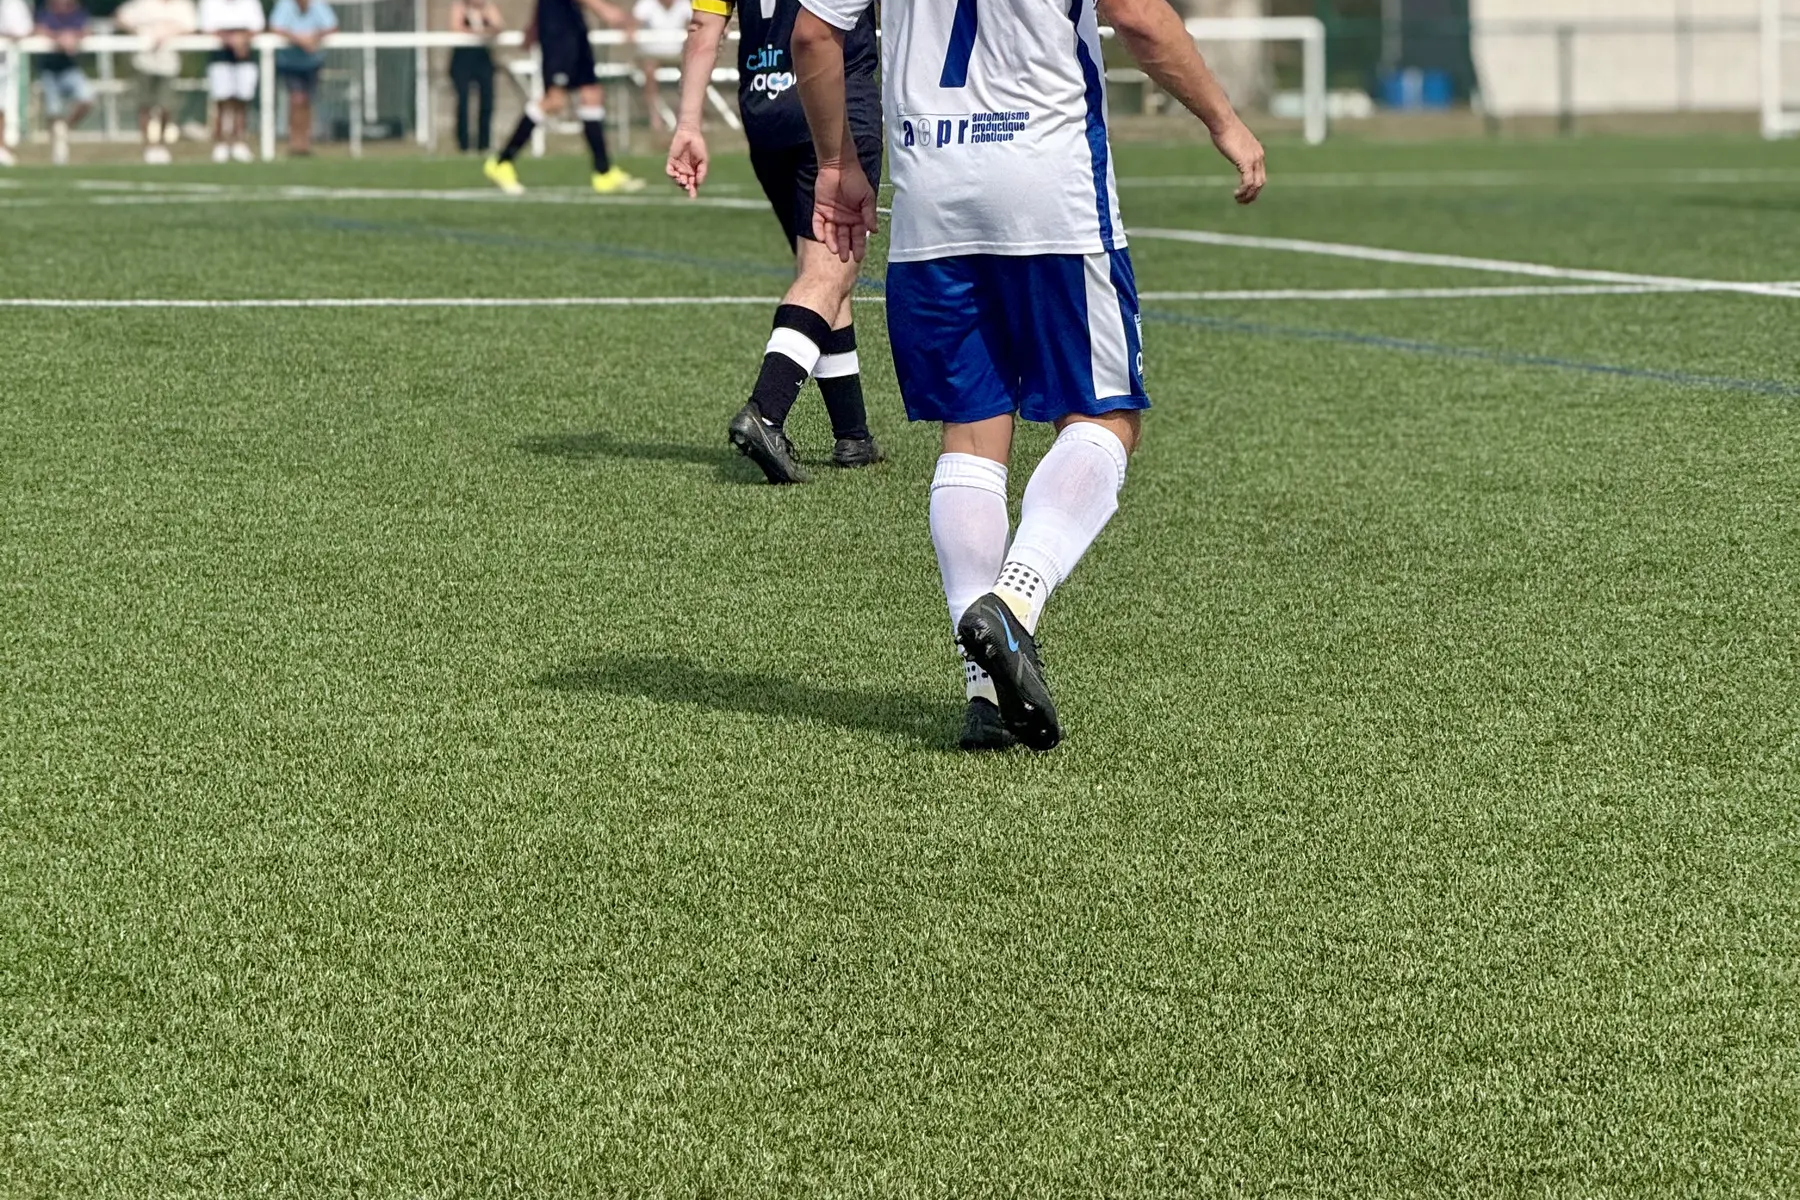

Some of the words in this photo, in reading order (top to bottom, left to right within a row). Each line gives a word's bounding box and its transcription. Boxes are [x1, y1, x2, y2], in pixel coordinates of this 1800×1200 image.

[972, 111, 1030, 122] automatisme
[972, 121, 1025, 134] productique
[971, 132, 1014, 144] robotique
